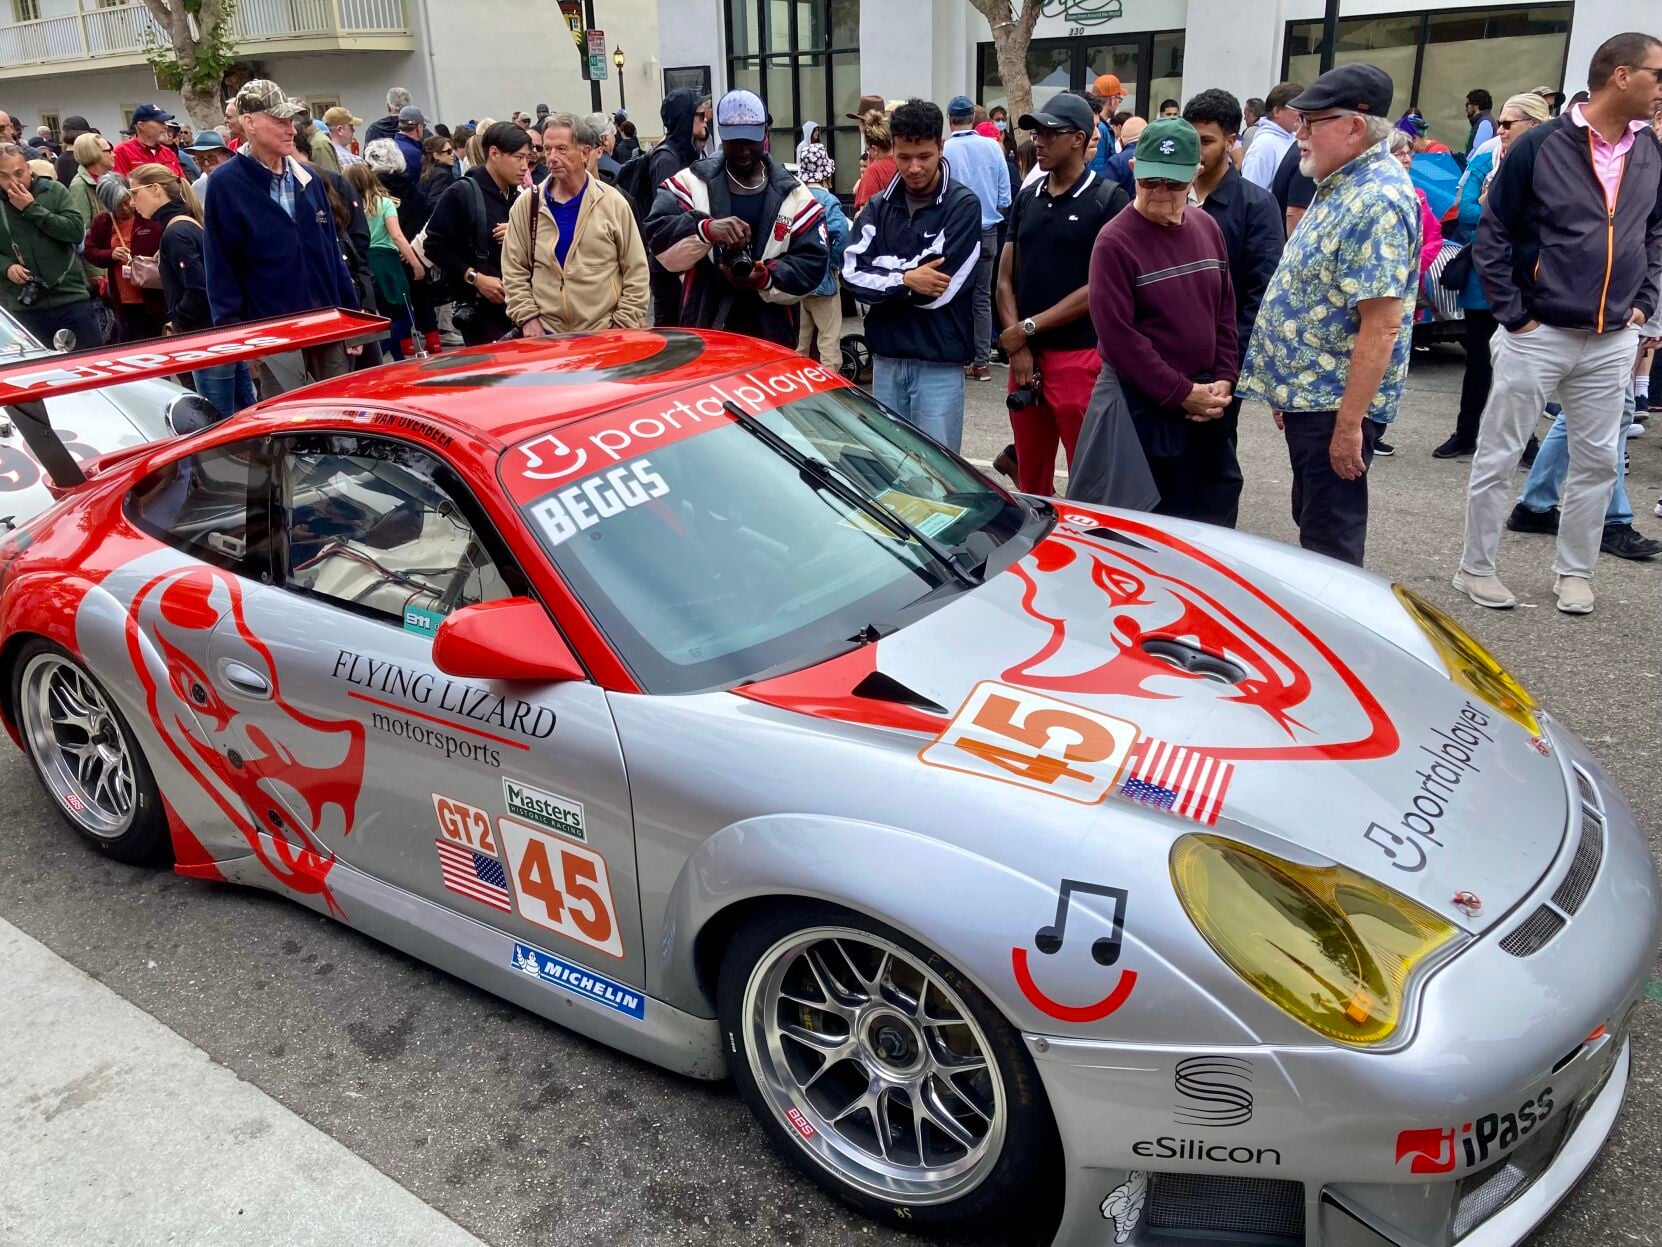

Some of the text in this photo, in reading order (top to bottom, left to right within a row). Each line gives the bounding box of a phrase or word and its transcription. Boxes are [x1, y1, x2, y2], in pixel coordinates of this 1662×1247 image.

[1068, 27, 1085, 36] 330
[100, 336, 290, 373] iPass
[374, 412, 395, 425] VAN
[589, 364, 834, 460] portalplayer
[529, 459, 670, 546] BEGGS
[406, 612, 430, 629] 911
[331, 650, 557, 739] FLYING LIZARD
[372, 712, 501, 768] motorsports
[954, 693, 1116, 785] 45
[1401, 701, 1494, 848] portalplayer
[66, 794, 84, 810] BBS
[508, 784, 581, 827] Masters
[510, 805, 582, 837] HISTORIC RACING
[437, 798, 494, 854] GT2
[518, 838, 611, 942] 45
[544, 962, 638, 1009] MICHELIN
[788, 1108, 814, 1135] BBS
[1461, 1086, 1554, 1168] iPass
[1131, 1136, 1281, 1166] eSilicon
